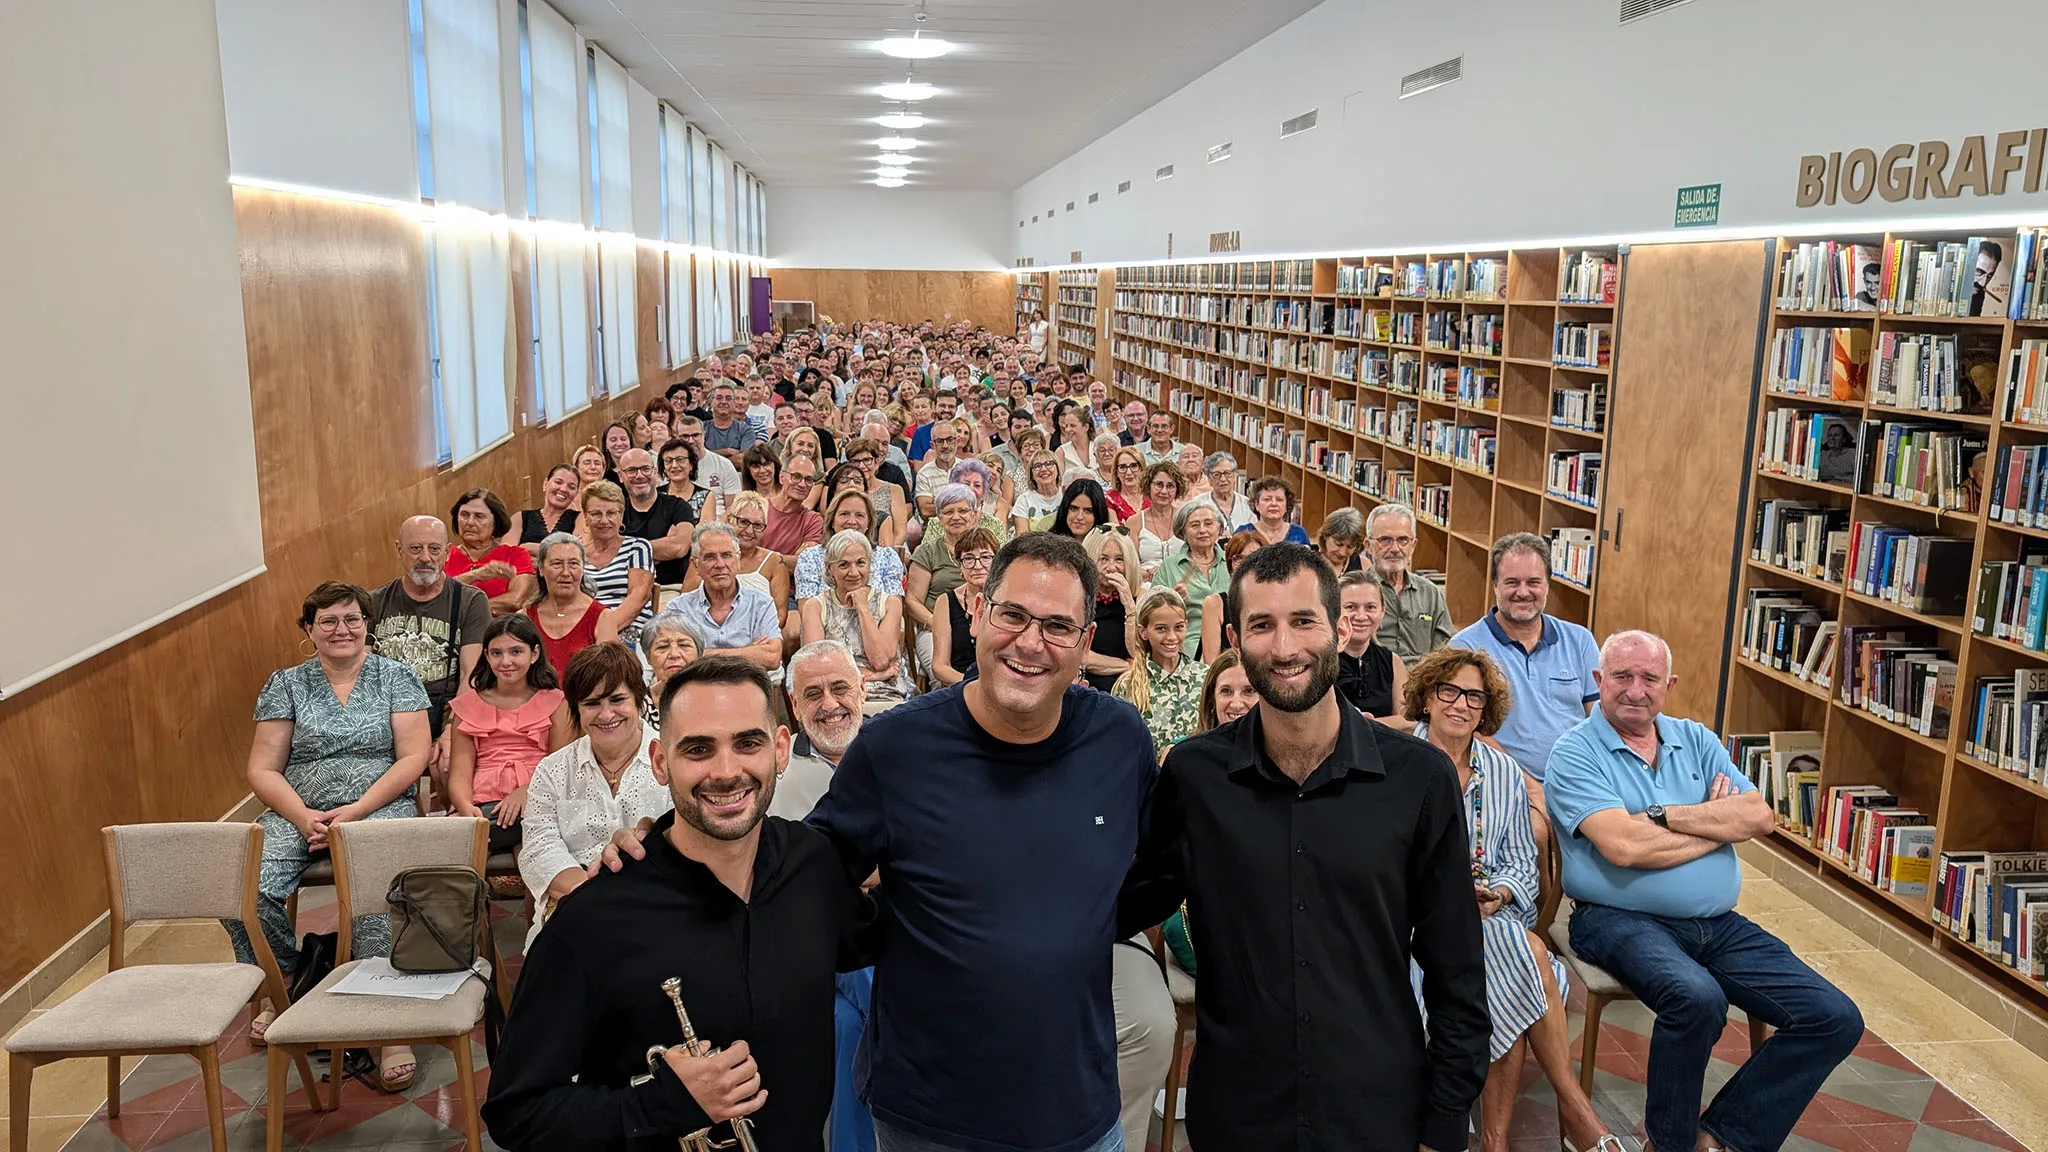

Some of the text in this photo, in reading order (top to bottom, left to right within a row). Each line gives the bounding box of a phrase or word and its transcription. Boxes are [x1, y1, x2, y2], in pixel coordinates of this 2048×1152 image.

[1796, 128, 2048, 208] BIOGRAFI
[1680, 187, 1718, 206] SALIDA DE
[1677, 206, 1716, 224] EMERGENCIA
[1962, 439, 1981, 448] Juan
